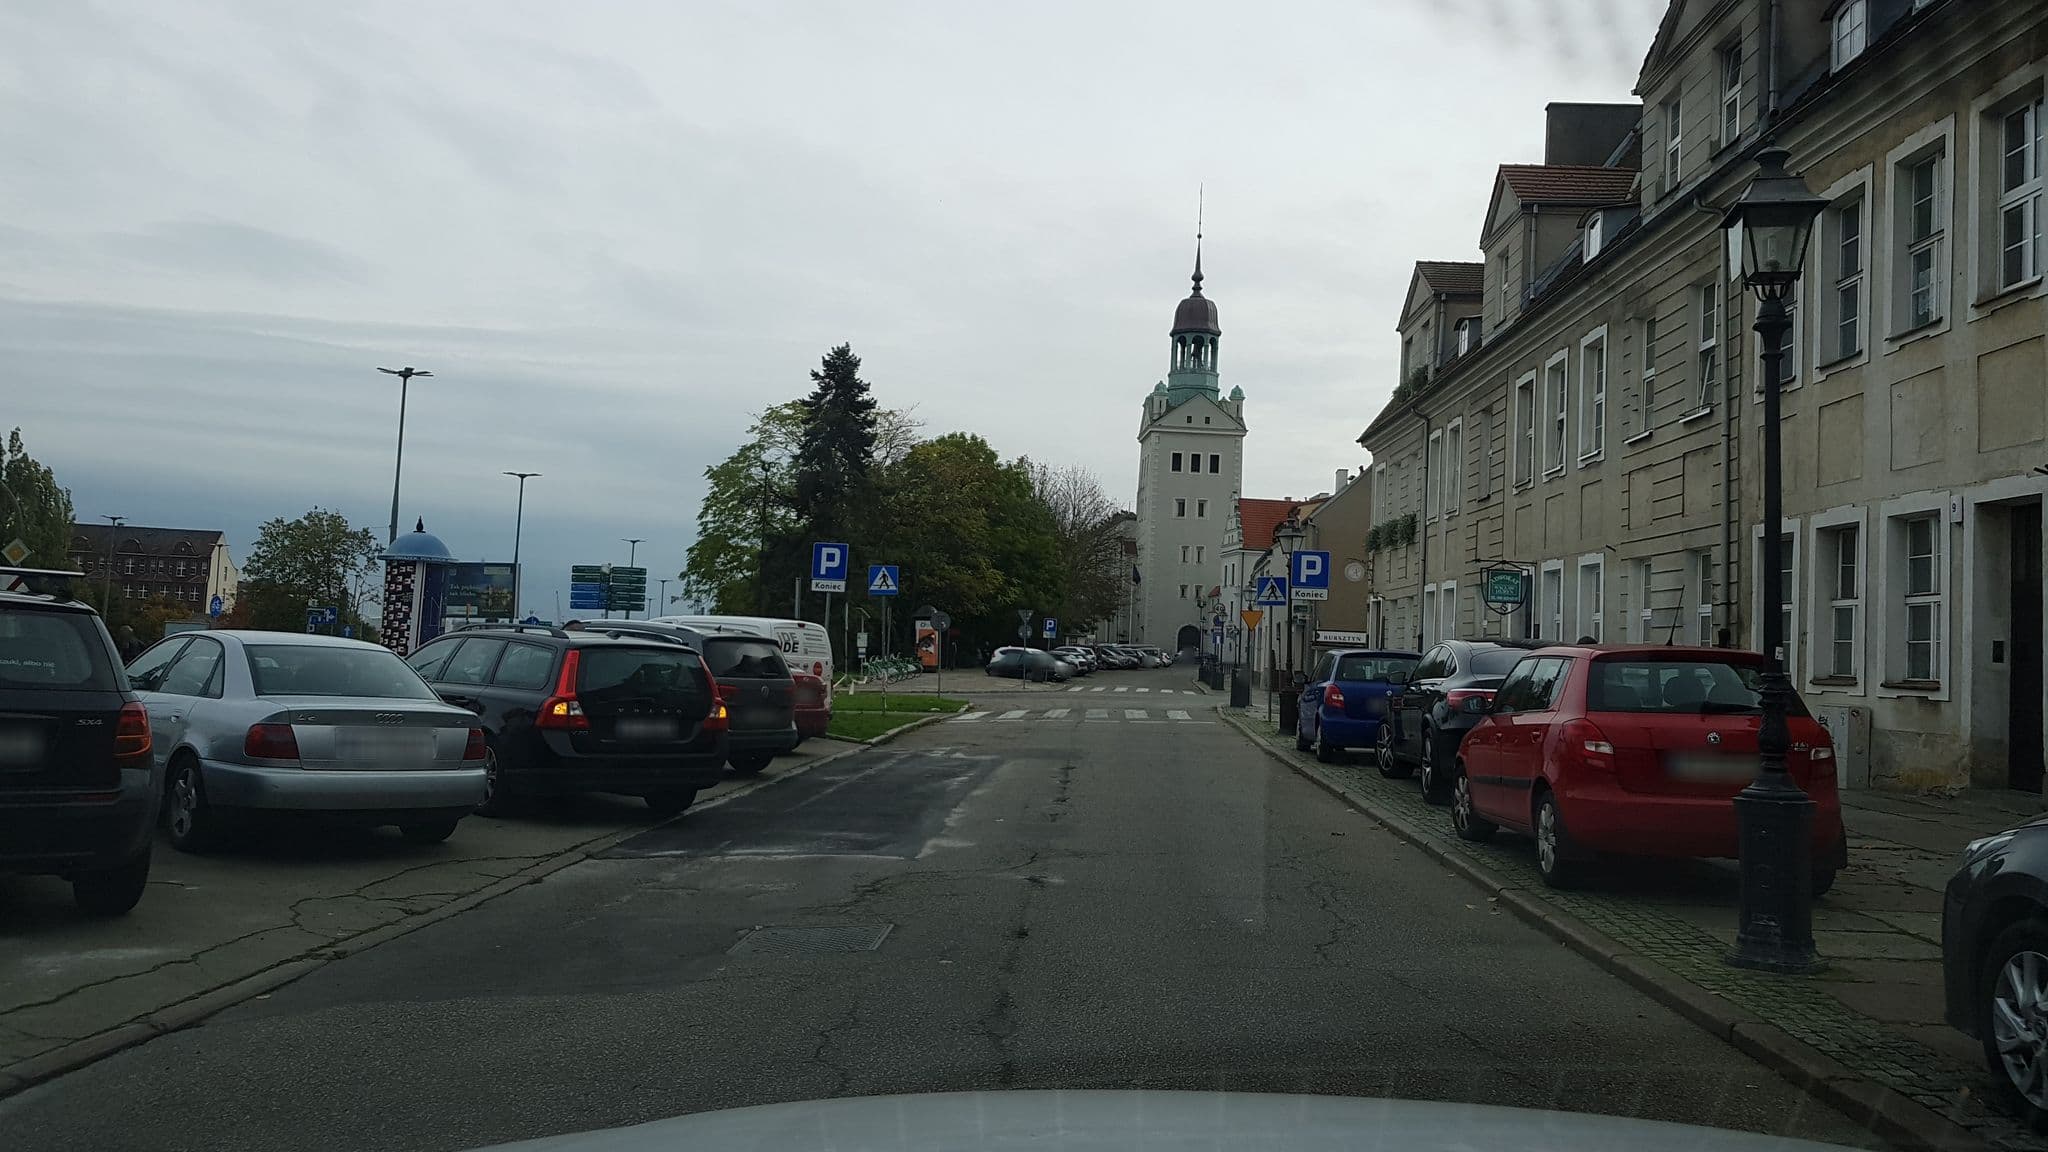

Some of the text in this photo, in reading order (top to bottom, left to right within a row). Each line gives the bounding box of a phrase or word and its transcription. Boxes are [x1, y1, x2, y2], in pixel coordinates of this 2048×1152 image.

[820, 547, 841, 575] P
[1300, 554, 1322, 583] P
[815, 582, 841, 591] Koniec
[1295, 589, 1324, 598] Koniec
[1046, 620, 1054, 630] P
[1323, 634, 1362, 642] BURSZTYN
[75, 718, 104, 727] SX4
